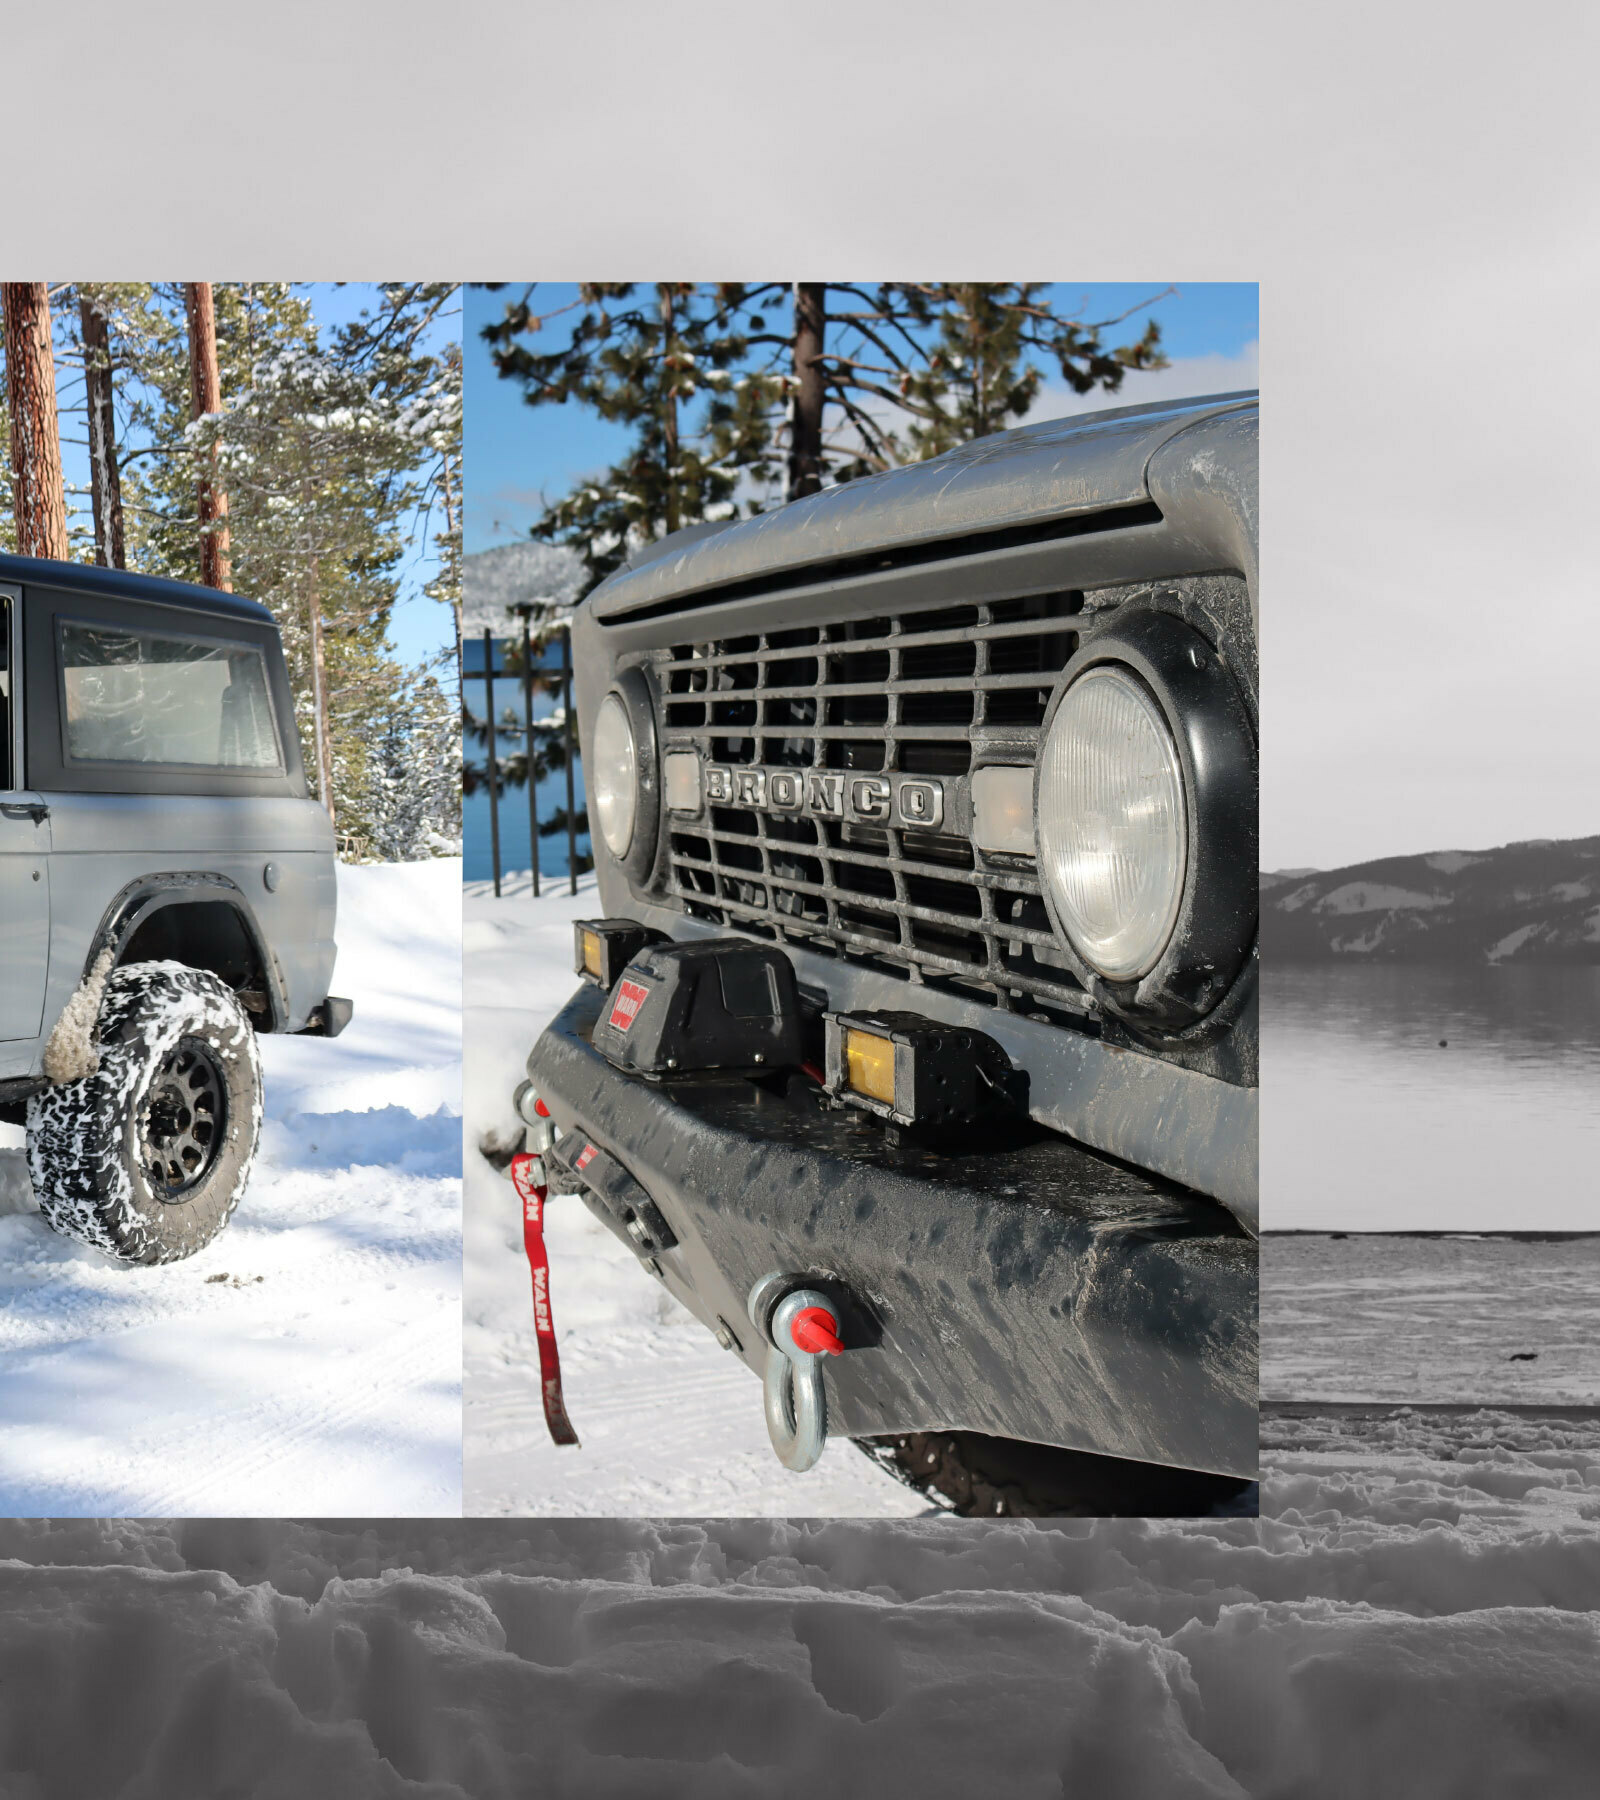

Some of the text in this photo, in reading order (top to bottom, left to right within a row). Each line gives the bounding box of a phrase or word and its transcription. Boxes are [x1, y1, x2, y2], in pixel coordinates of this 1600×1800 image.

[705, 767, 943, 827] BRONCO
[514, 1159, 540, 1222] WARN
[533, 1266, 551, 1332] WARN
